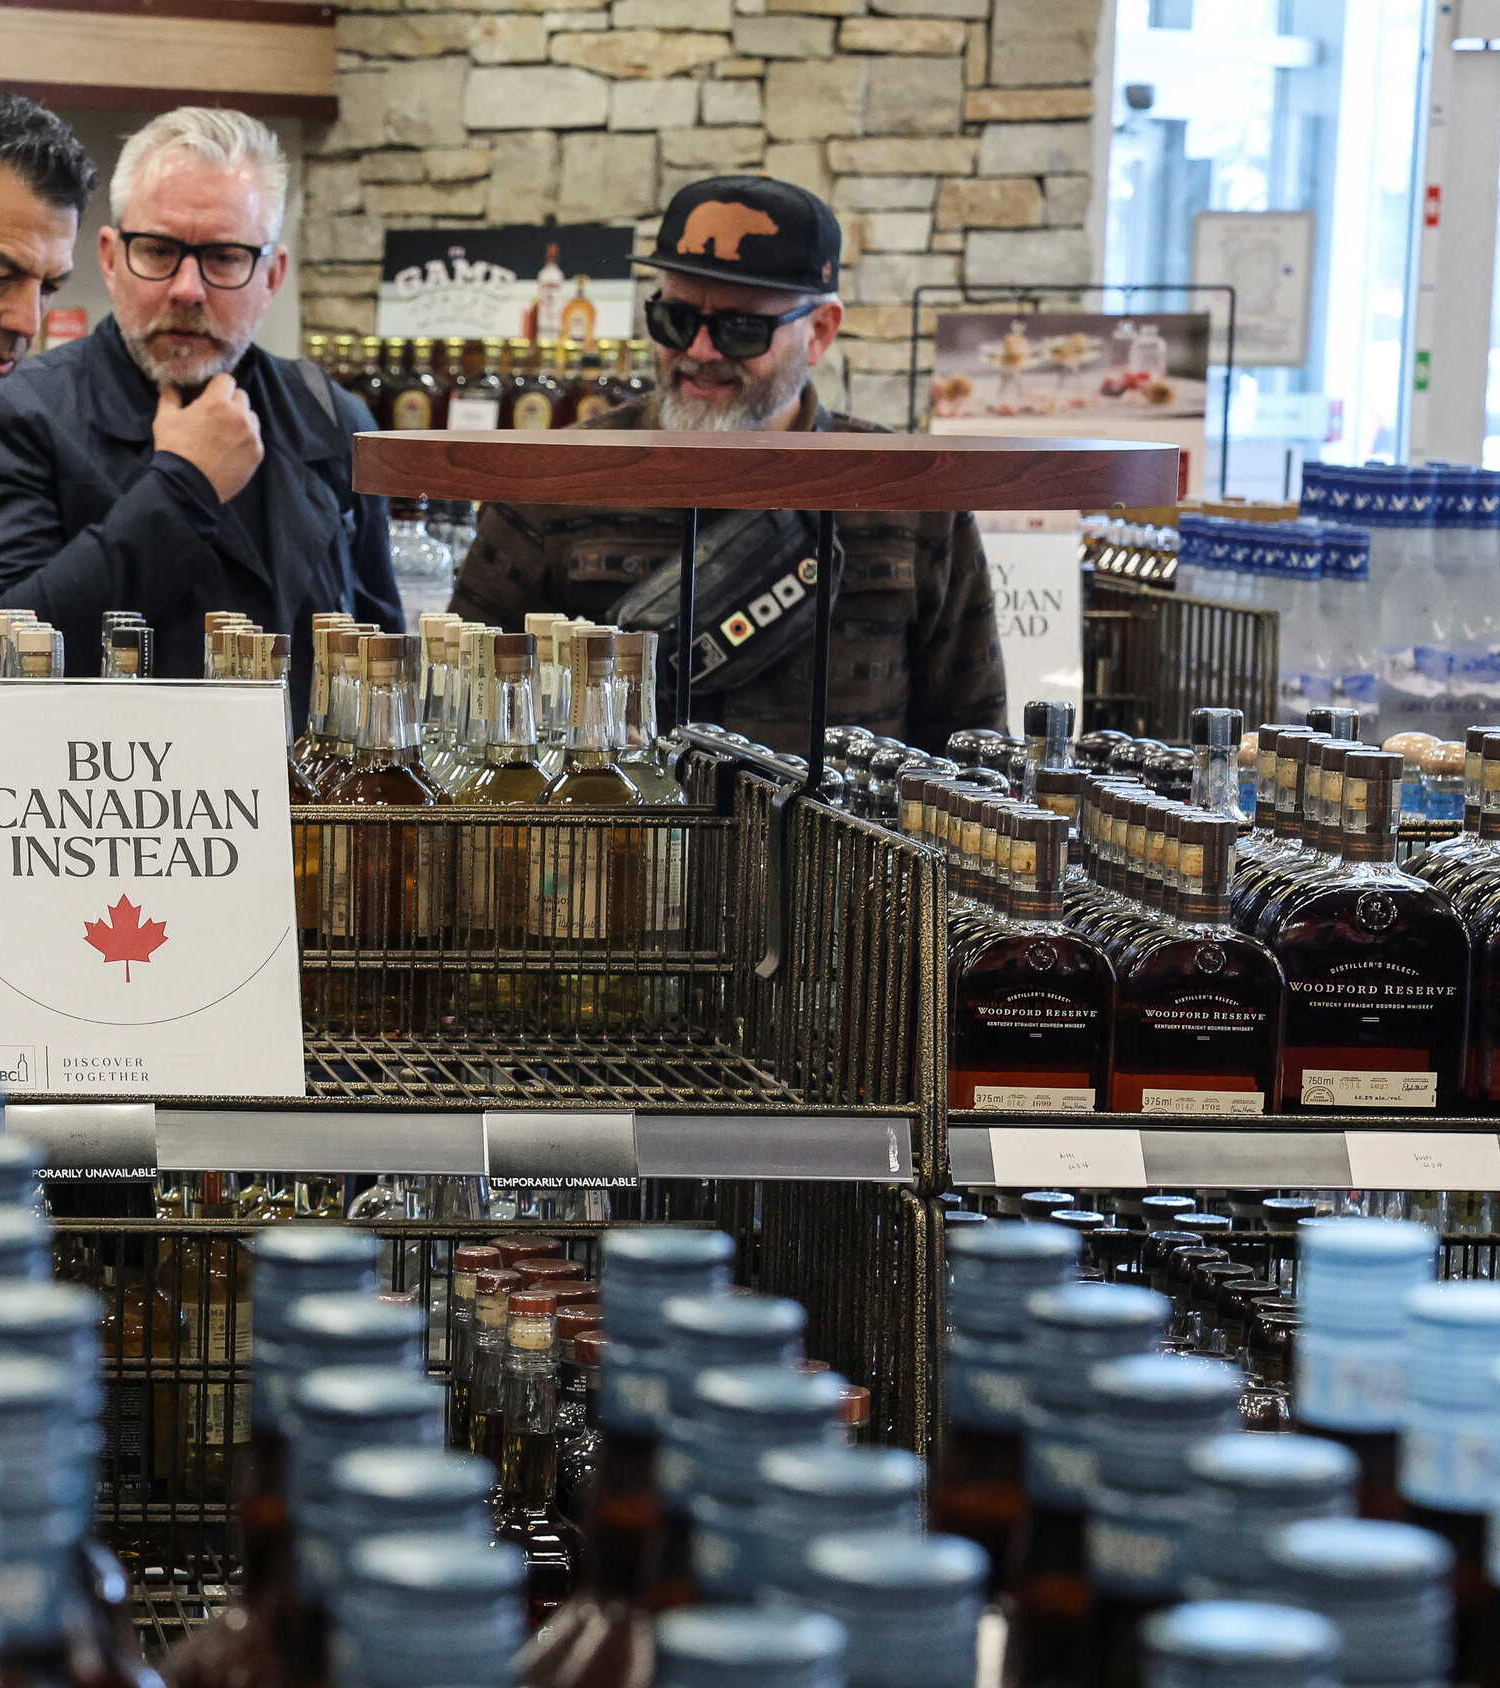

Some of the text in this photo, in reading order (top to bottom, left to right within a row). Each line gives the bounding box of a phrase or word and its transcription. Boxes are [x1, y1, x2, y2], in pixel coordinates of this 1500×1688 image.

[995, 589, 1061, 611] DIAN
[67, 741, 174, 783] BUY
[11, 836, 239, 878] INSTEAD
[1330, 961, 1417, 976] DISTILLER'S SELECT
[1289, 981, 1454, 996] WOODFORD RESERVE
[1007, 991, 1070, 1003] DISTILLER'S SELECT
[1175, 995, 1238, 1006] DISTILLER'S SELECT
[978, 1006, 1097, 1018] WOODFORD RESERVE
[1145, 1009, 1265, 1021] WOODFORD RESERVE
[63, 1057, 144, 1067] DISCOVER
[64, 1072, 150, 1082] TOGETHER
[32, 1168, 158, 1178] PORARILY UNAVAILABLE
[491, 1177, 638, 1187] TEMPORARILY UNAVAILABLE
